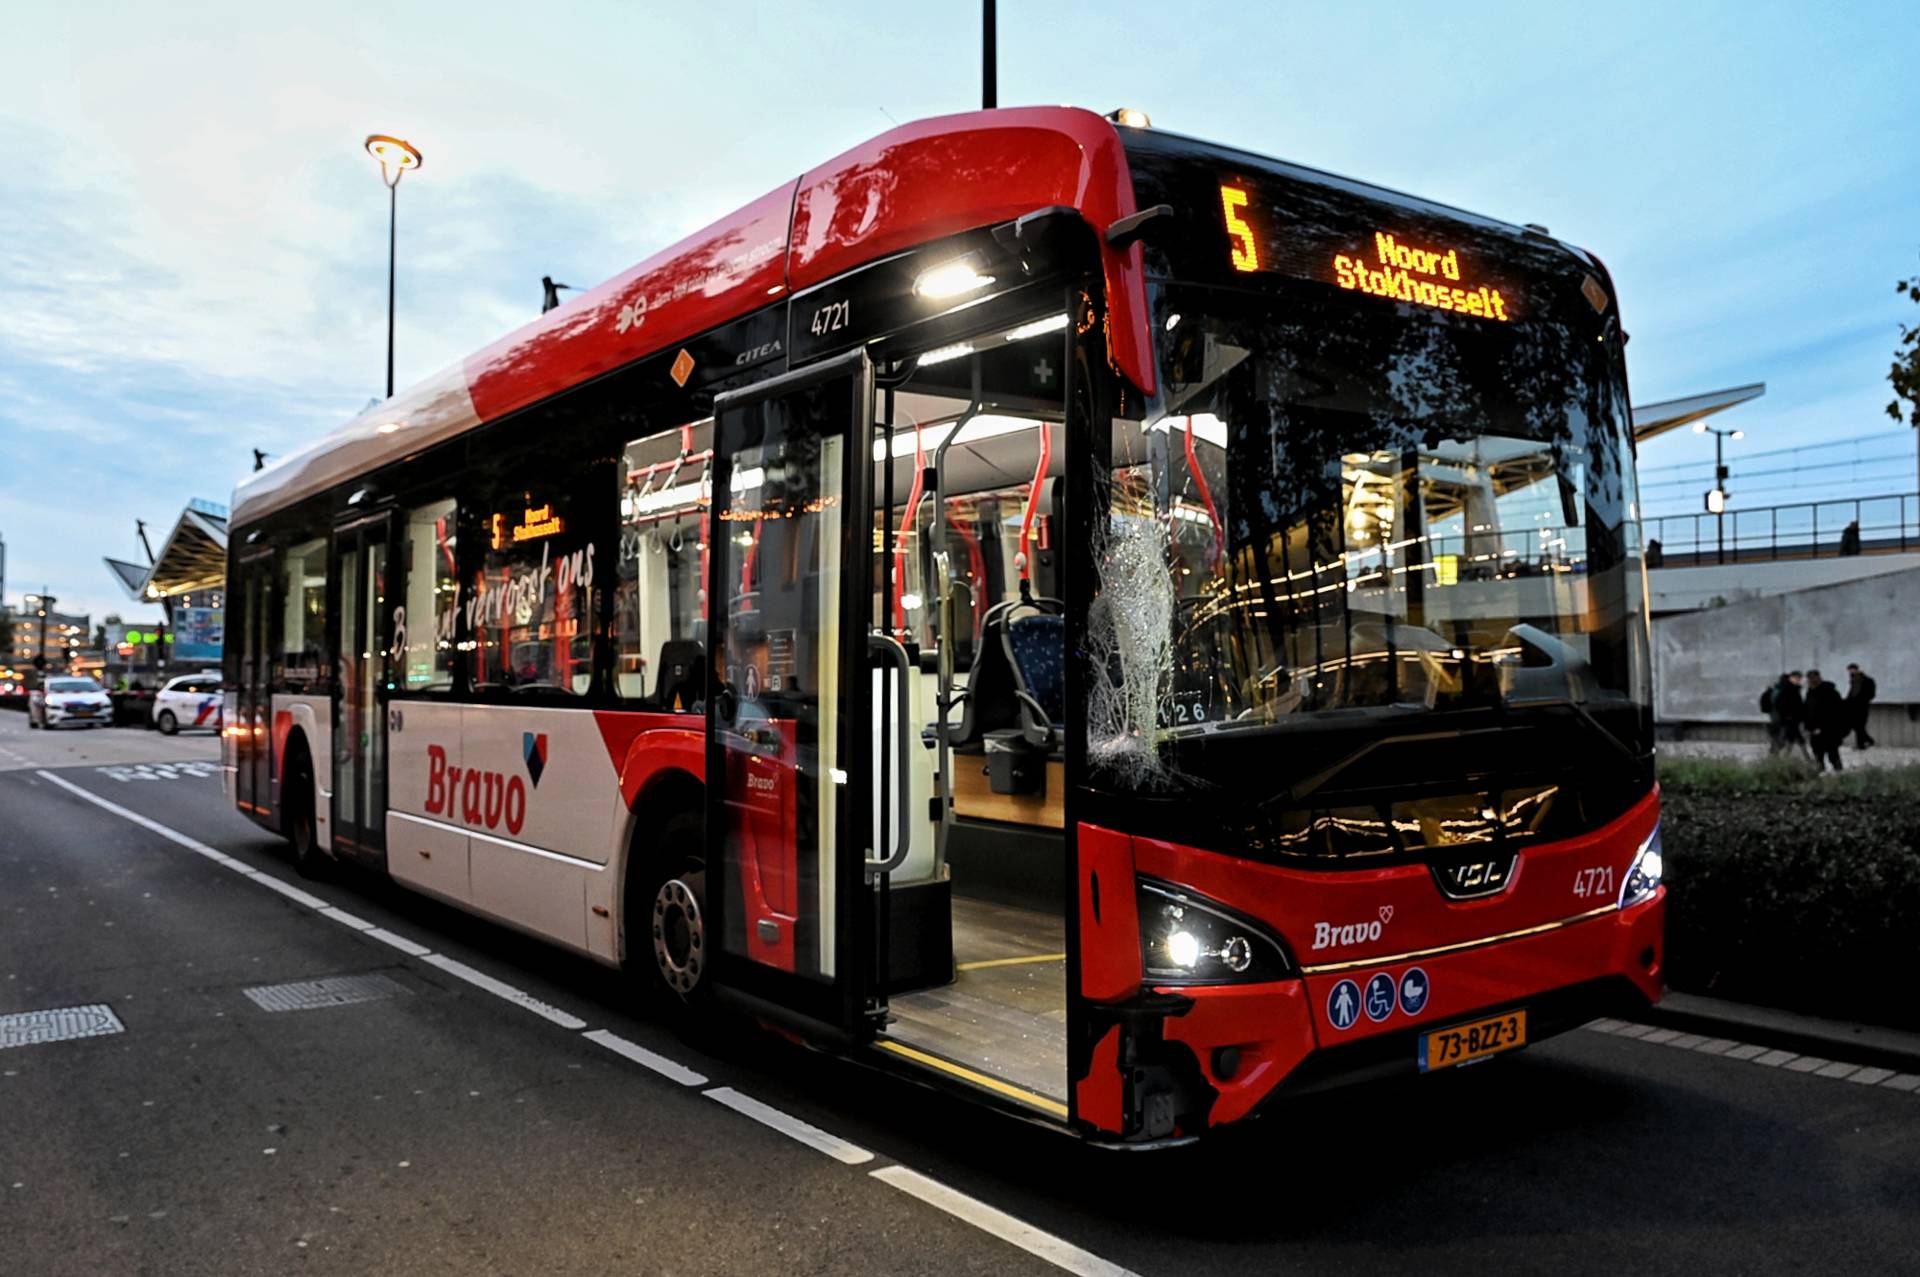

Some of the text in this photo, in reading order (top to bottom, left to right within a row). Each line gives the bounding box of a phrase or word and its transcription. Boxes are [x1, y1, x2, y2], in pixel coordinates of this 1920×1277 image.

[1221, 185, 1258, 272] 5
[1375, 231, 1459, 281] Noord
[1334, 254, 1508, 321] Stokhasselt
[811, 299, 850, 337] 4721
[735, 339, 782, 366] CITEA
[491, 512, 502, 550] 5
[557, 542, 596, 594] ons
[424, 743, 527, 836] Bravo
[746, 772, 775, 791] Bravo
[1572, 865, 1614, 898] 4721
[1311, 919, 1382, 951] Bravo
[1438, 1016, 1519, 1062] 73-BZZ-3
